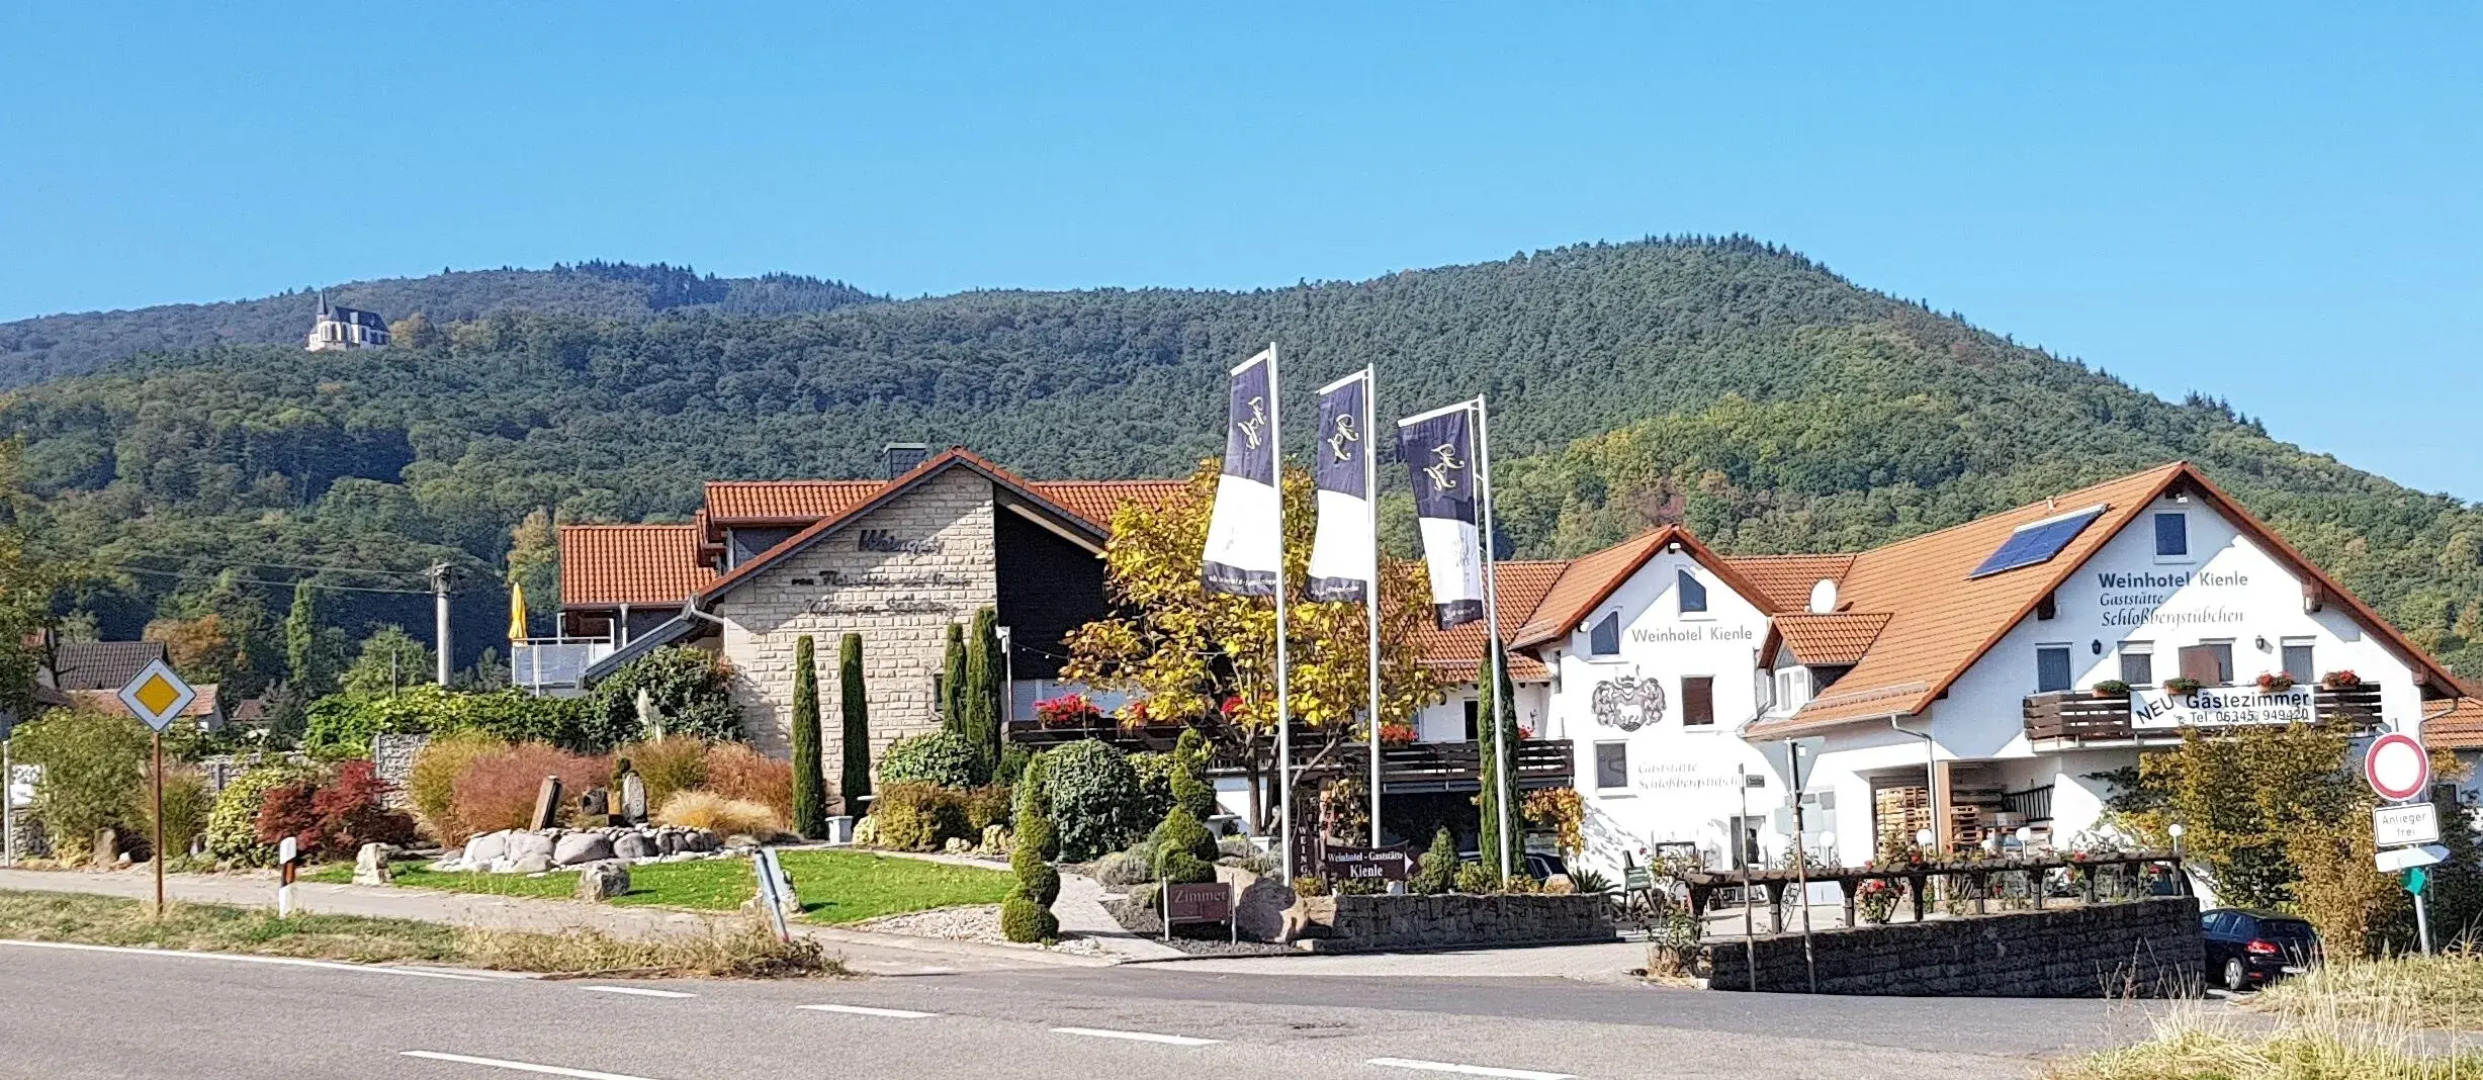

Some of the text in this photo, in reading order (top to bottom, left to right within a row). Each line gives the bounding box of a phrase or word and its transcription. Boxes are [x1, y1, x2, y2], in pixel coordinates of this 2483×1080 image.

[2098, 571, 2249, 588] Weinhotel Kienle
[2100, 591, 2164, 606] Gaststätte
[2101, 604, 2244, 629] Schloßbergstübchen
[1632, 625, 1753, 642] Weinhotel Kienle
[2185, 692, 2310, 710] Gästezimmer
[2136, 694, 2174, 725] NEU
[2190, 711, 2213, 723] Tel.
[1638, 762, 1697, 774] Gaststätte
[2382, 813, 2426, 824] Anlieger
[2397, 827, 2416, 837] frei
[1327, 852, 1363, 862] Weinhotel
[1368, 851, 1404, 860] Gaststätte
[1350, 864, 1383, 877] Kienle
[1174, 889, 1227, 903] Zimmer
